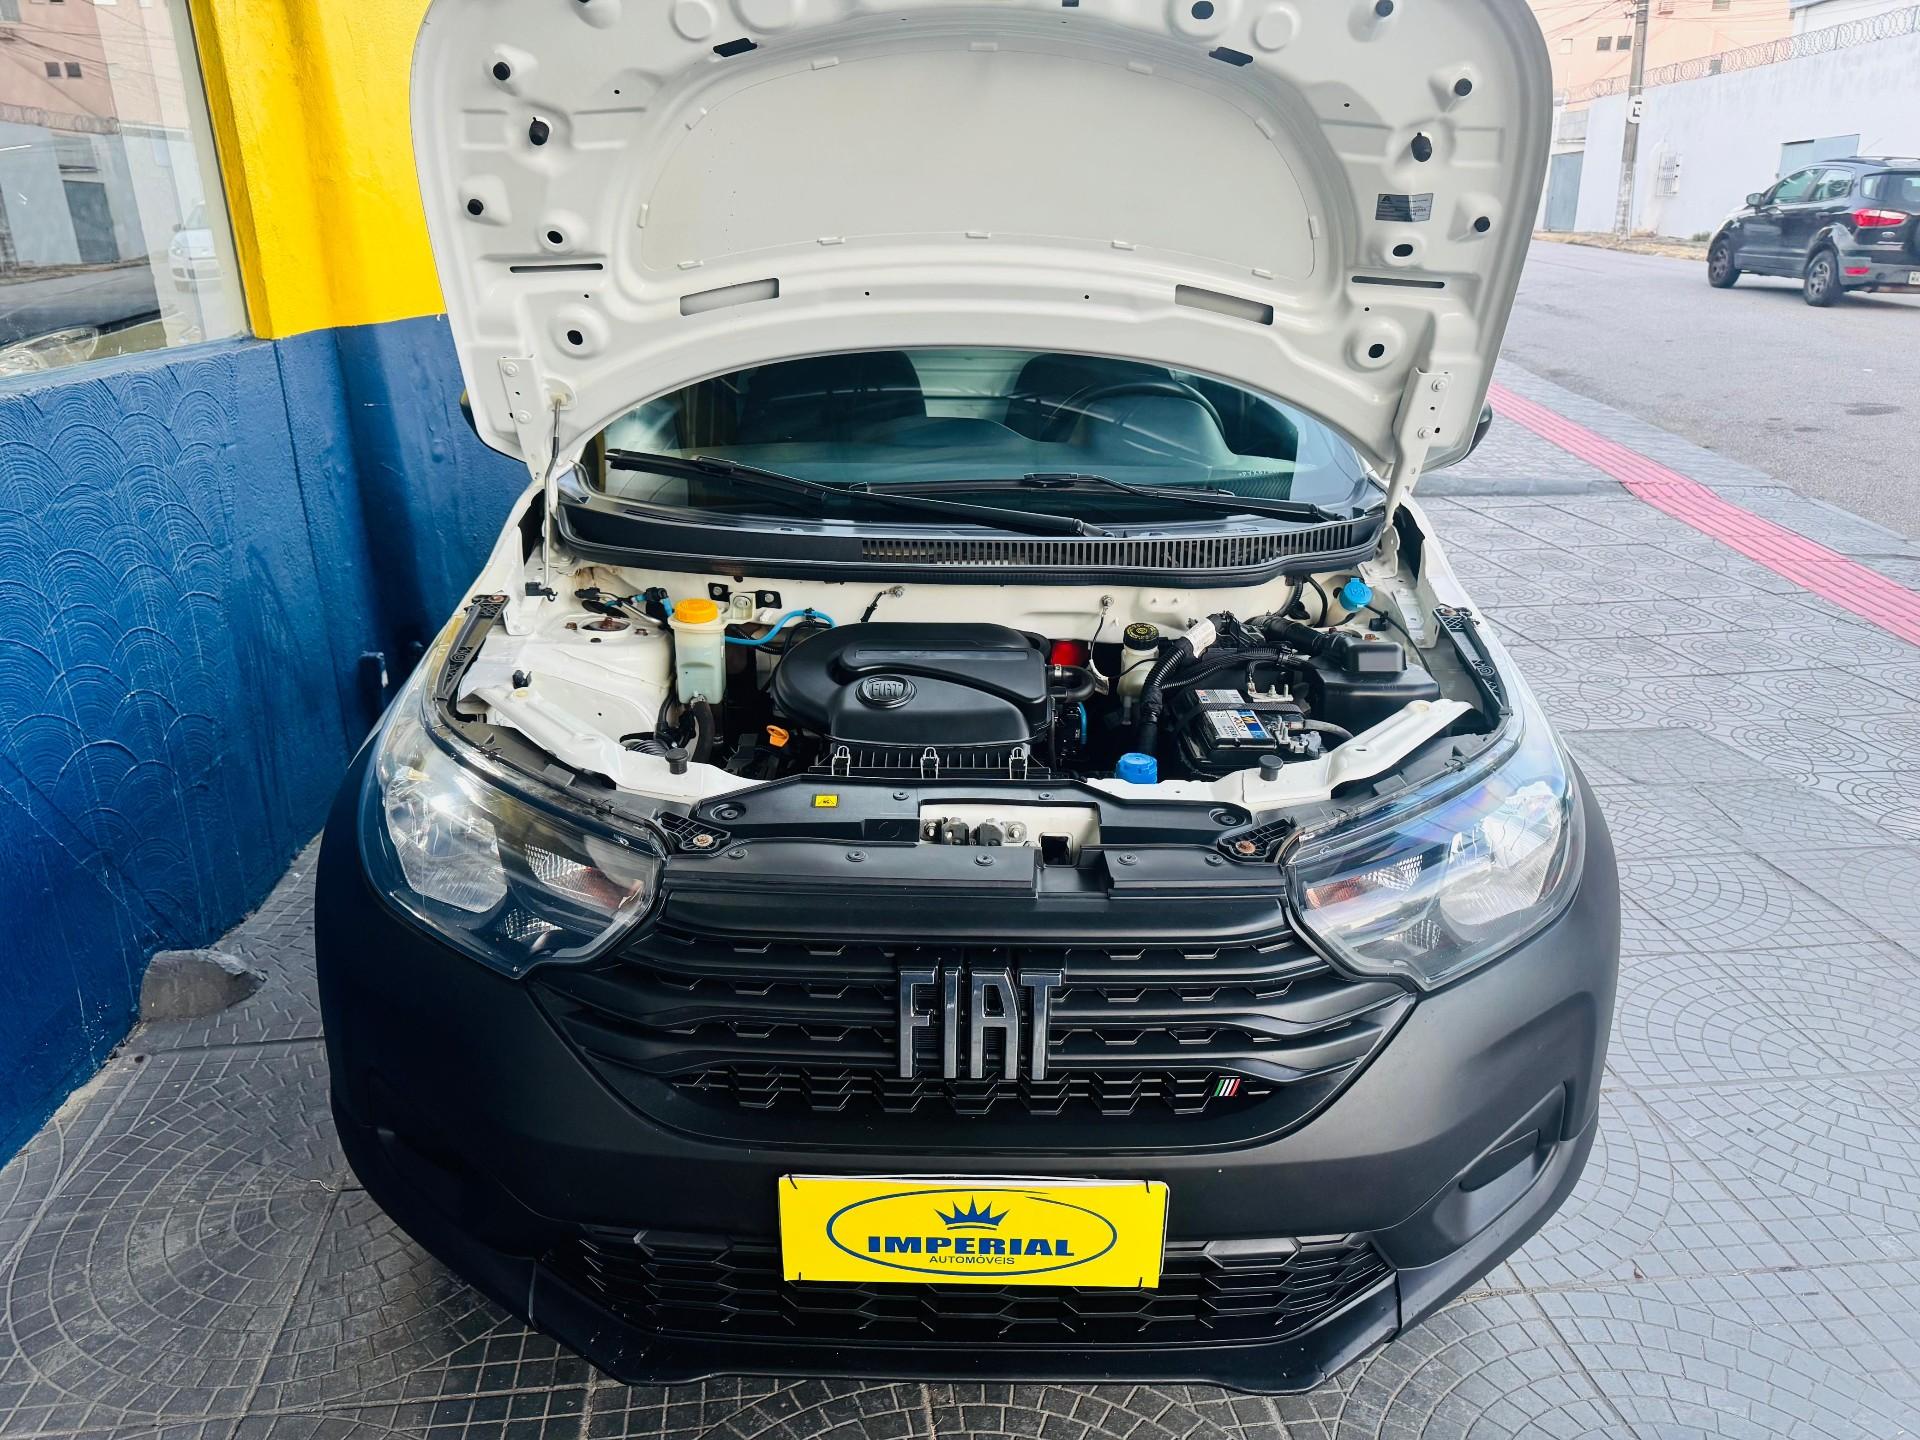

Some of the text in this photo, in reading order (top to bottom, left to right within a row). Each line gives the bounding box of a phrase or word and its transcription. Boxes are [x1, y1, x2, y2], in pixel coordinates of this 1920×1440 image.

[868, 680, 904, 697] FIAT
[899, 967, 1064, 1081] FIAT
[868, 1236, 1075, 1256] IMPERIAL
[929, 1255, 1015, 1265] AUTOMÓVEIS
